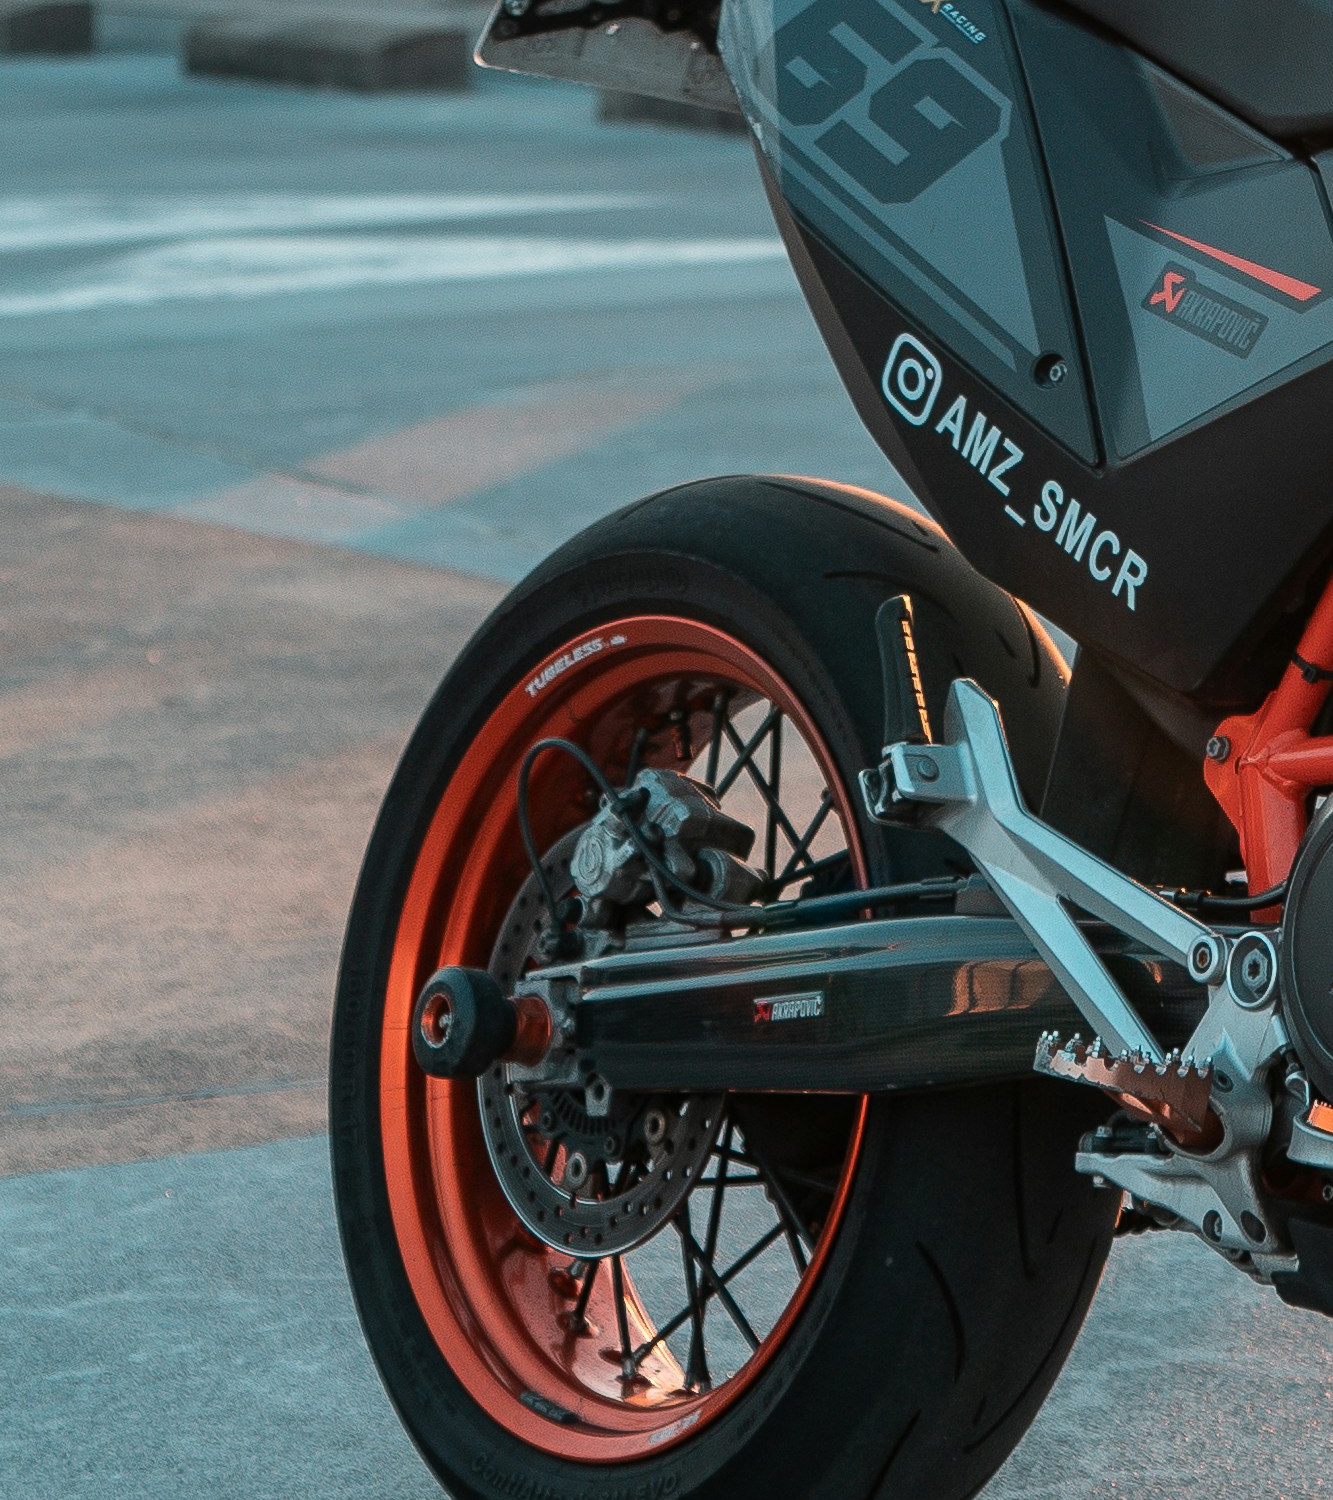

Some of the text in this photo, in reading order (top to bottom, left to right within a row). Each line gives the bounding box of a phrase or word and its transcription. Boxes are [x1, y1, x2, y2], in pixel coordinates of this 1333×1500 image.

[940, 3, 987, 44] RACING
[934, 394, 1150, 612] AMZ_SMCR
[525, 637, 604, 698] TUBELESS
